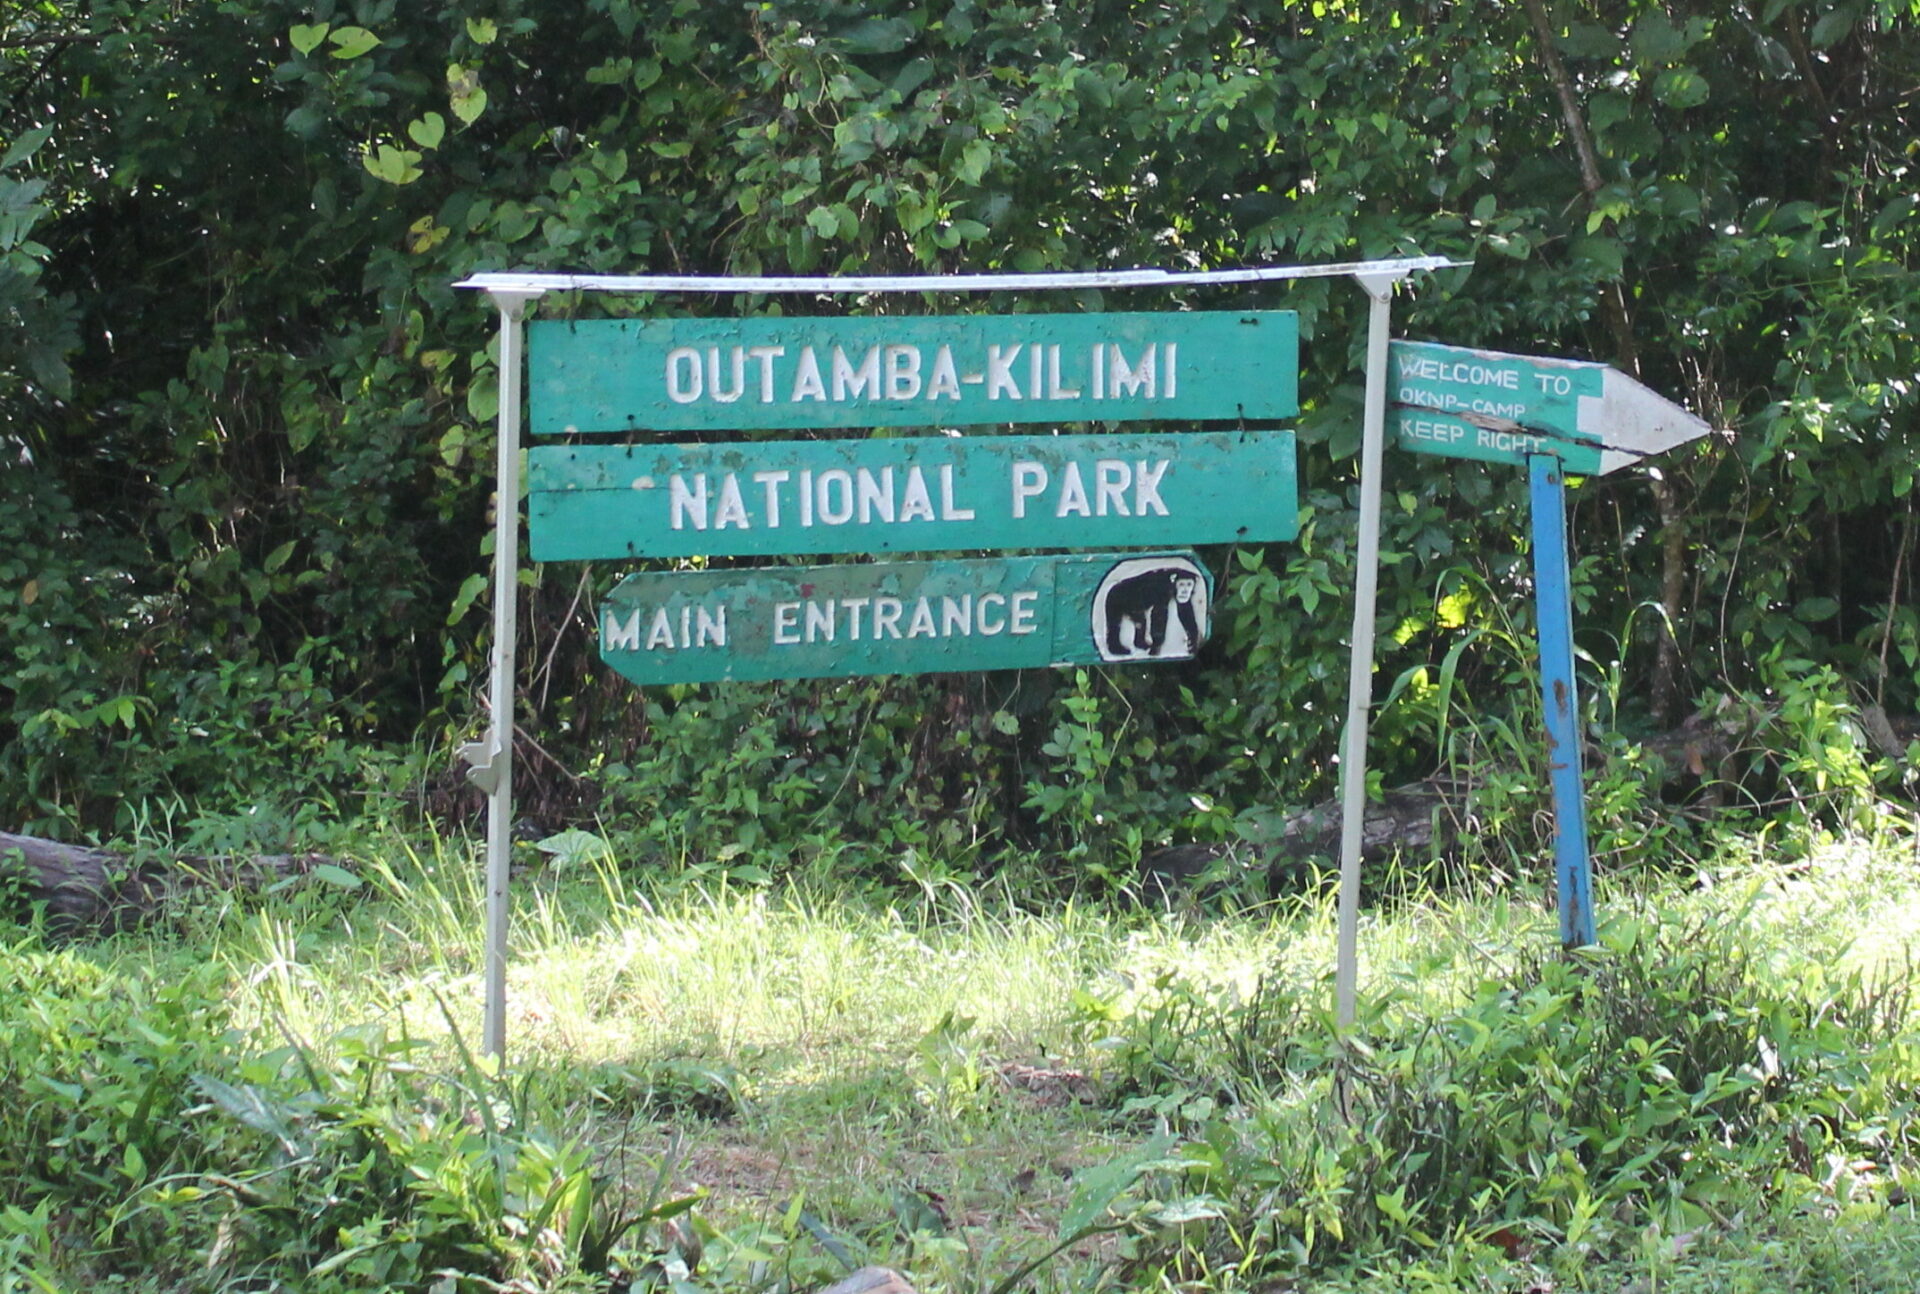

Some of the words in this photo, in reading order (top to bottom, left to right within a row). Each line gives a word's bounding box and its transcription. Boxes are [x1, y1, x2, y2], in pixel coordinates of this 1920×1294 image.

[666, 343, 1178, 404] OUTAMBA-KILIMI
[1399, 358, 1519, 391] WELCOME
[1534, 372, 1571, 395] TO
[1400, 387, 1526, 418] OKNP-CAMP
[1400, 419, 1464, 444] KEEP
[1478, 430, 1548, 454] RIGHT
[668, 464, 975, 531] NATIONAL
[1012, 458, 1170, 518] PARK
[604, 603, 728, 652] MAIN
[774, 590, 1040, 646] ENTRANCE
